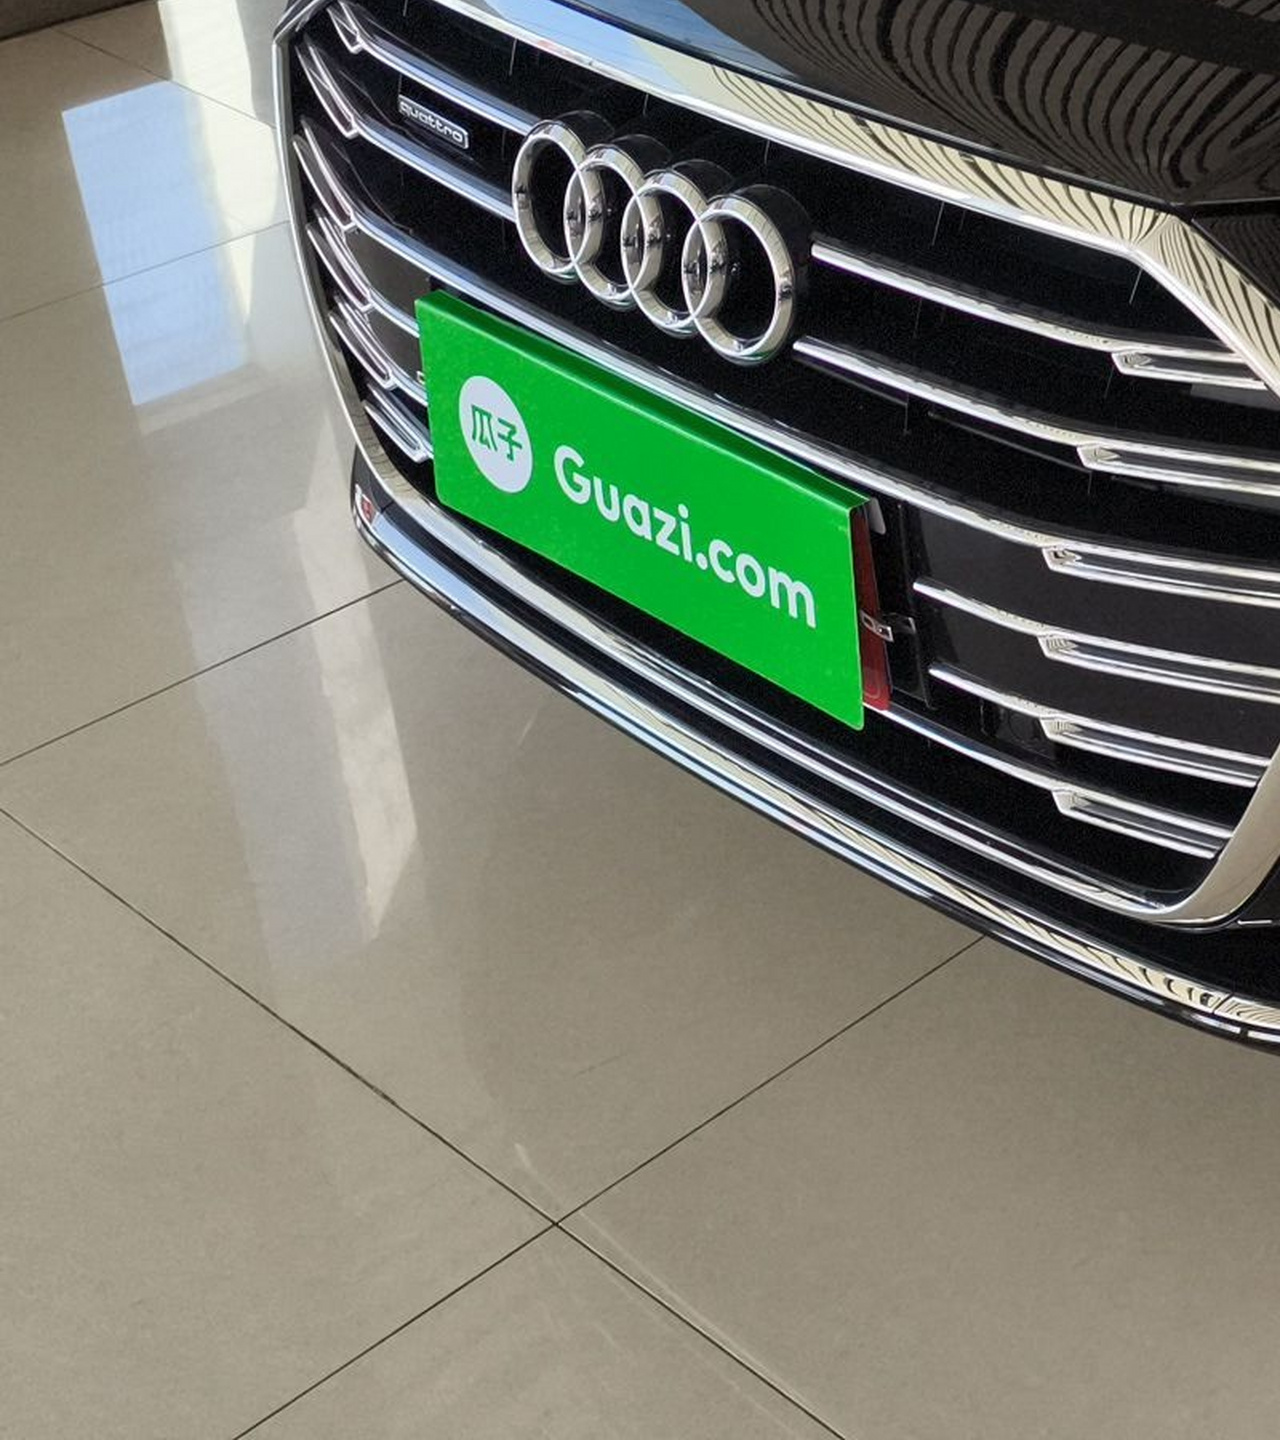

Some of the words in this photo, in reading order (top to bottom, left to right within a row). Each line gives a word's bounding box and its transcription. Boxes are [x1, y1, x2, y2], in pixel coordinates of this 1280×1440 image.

[400, 100, 464, 143] quattro
[471, 404, 523, 462] 瓜子
[553, 444, 817, 629] Guazi.com
